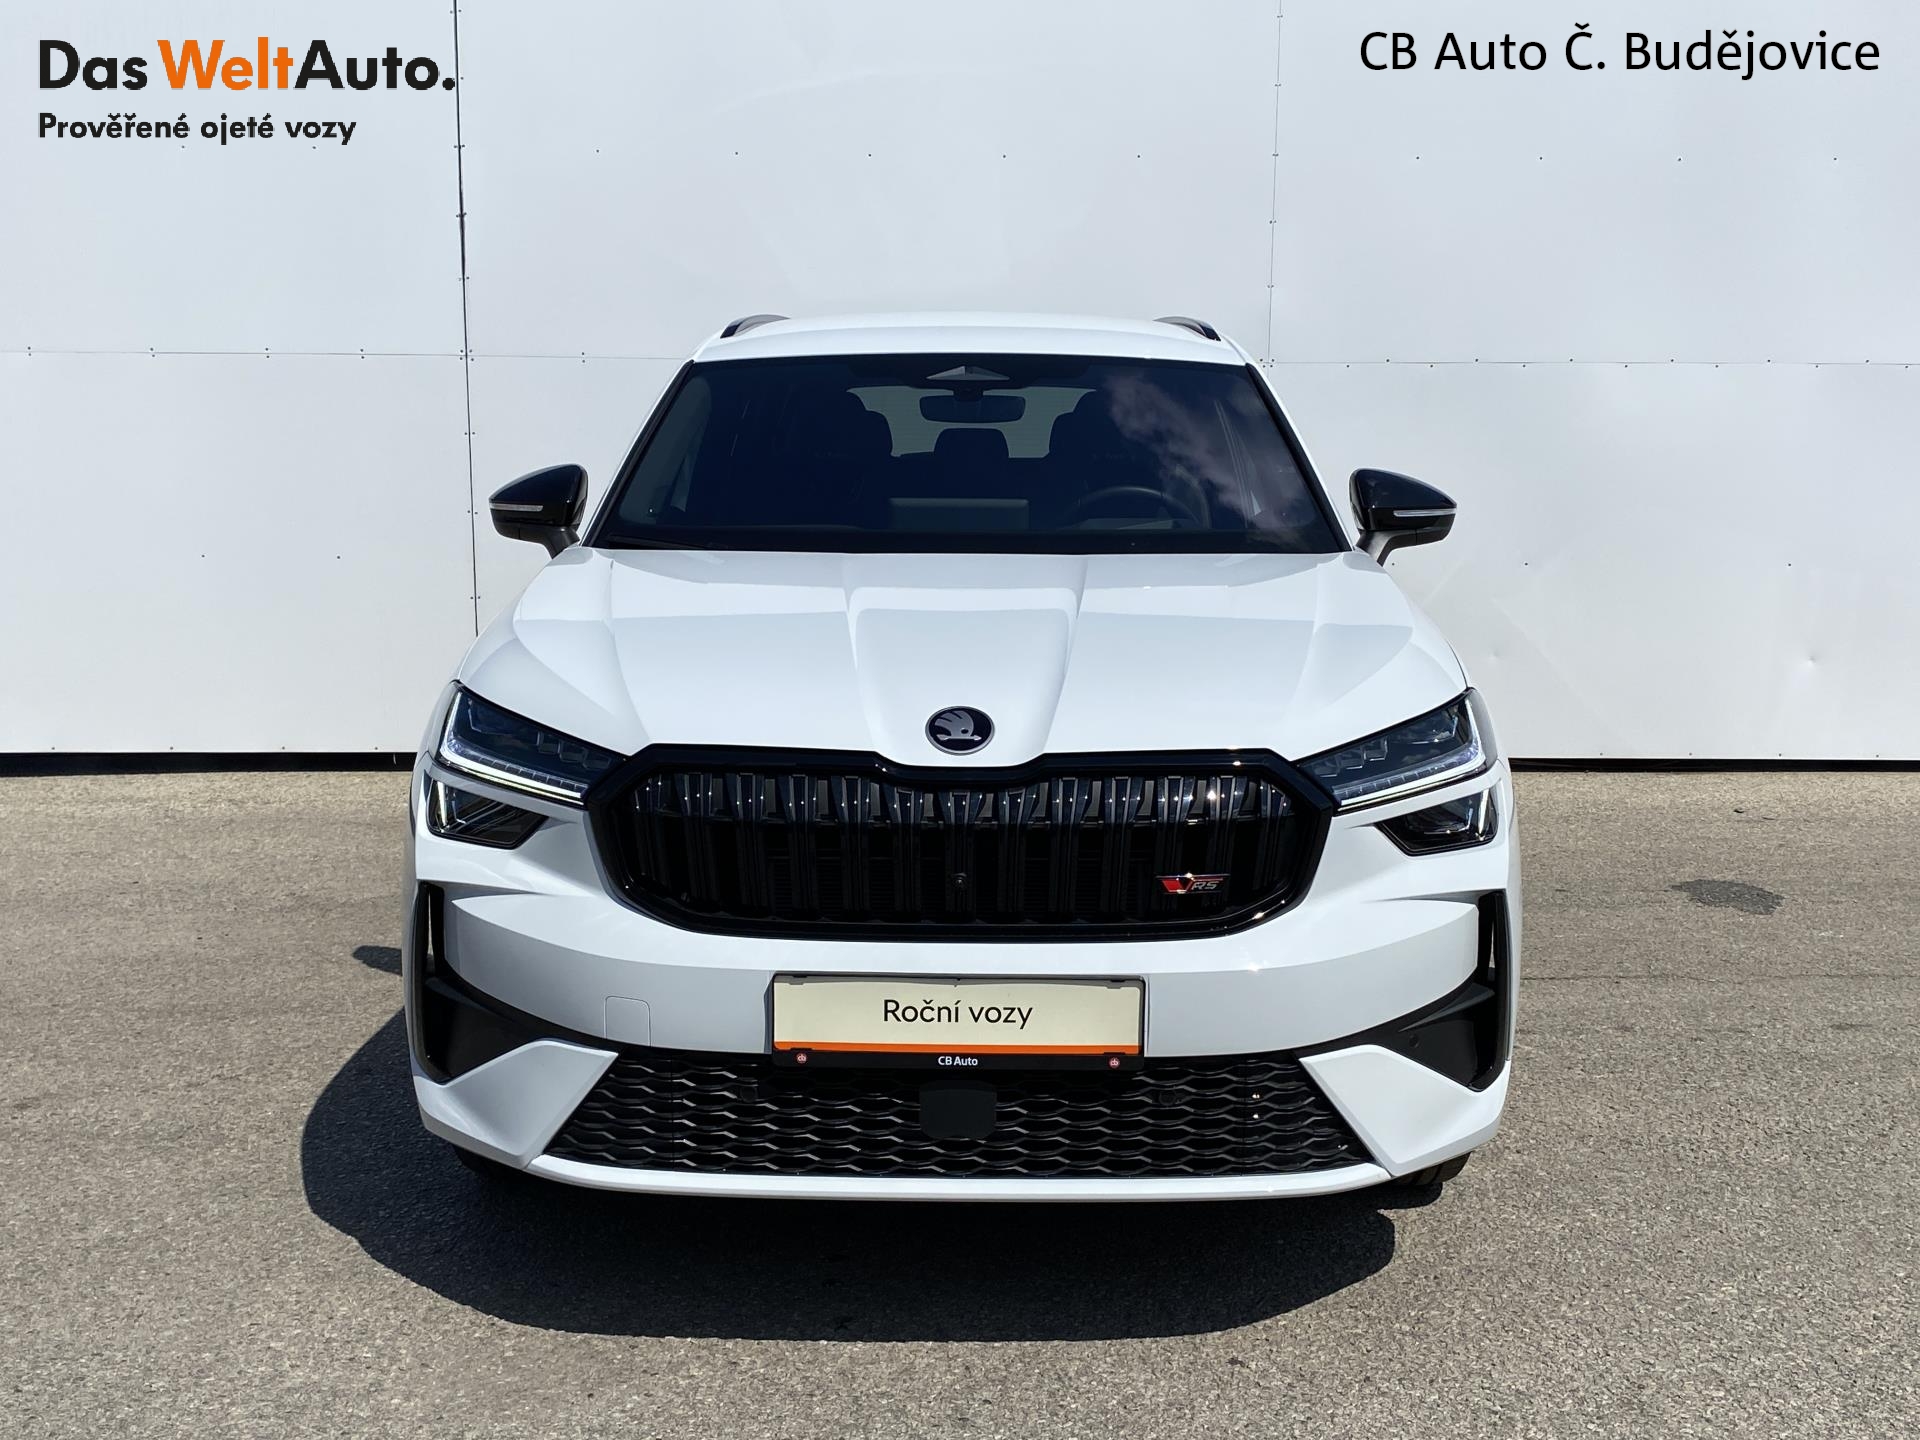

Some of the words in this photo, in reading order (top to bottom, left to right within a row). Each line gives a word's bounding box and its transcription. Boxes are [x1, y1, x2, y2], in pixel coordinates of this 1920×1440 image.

[883, 999, 961, 1023] Roční
[969, 1006, 1033, 1030] vozy
[937, 1055, 953, 1066] CB
[953, 1055, 979, 1066] Auto
